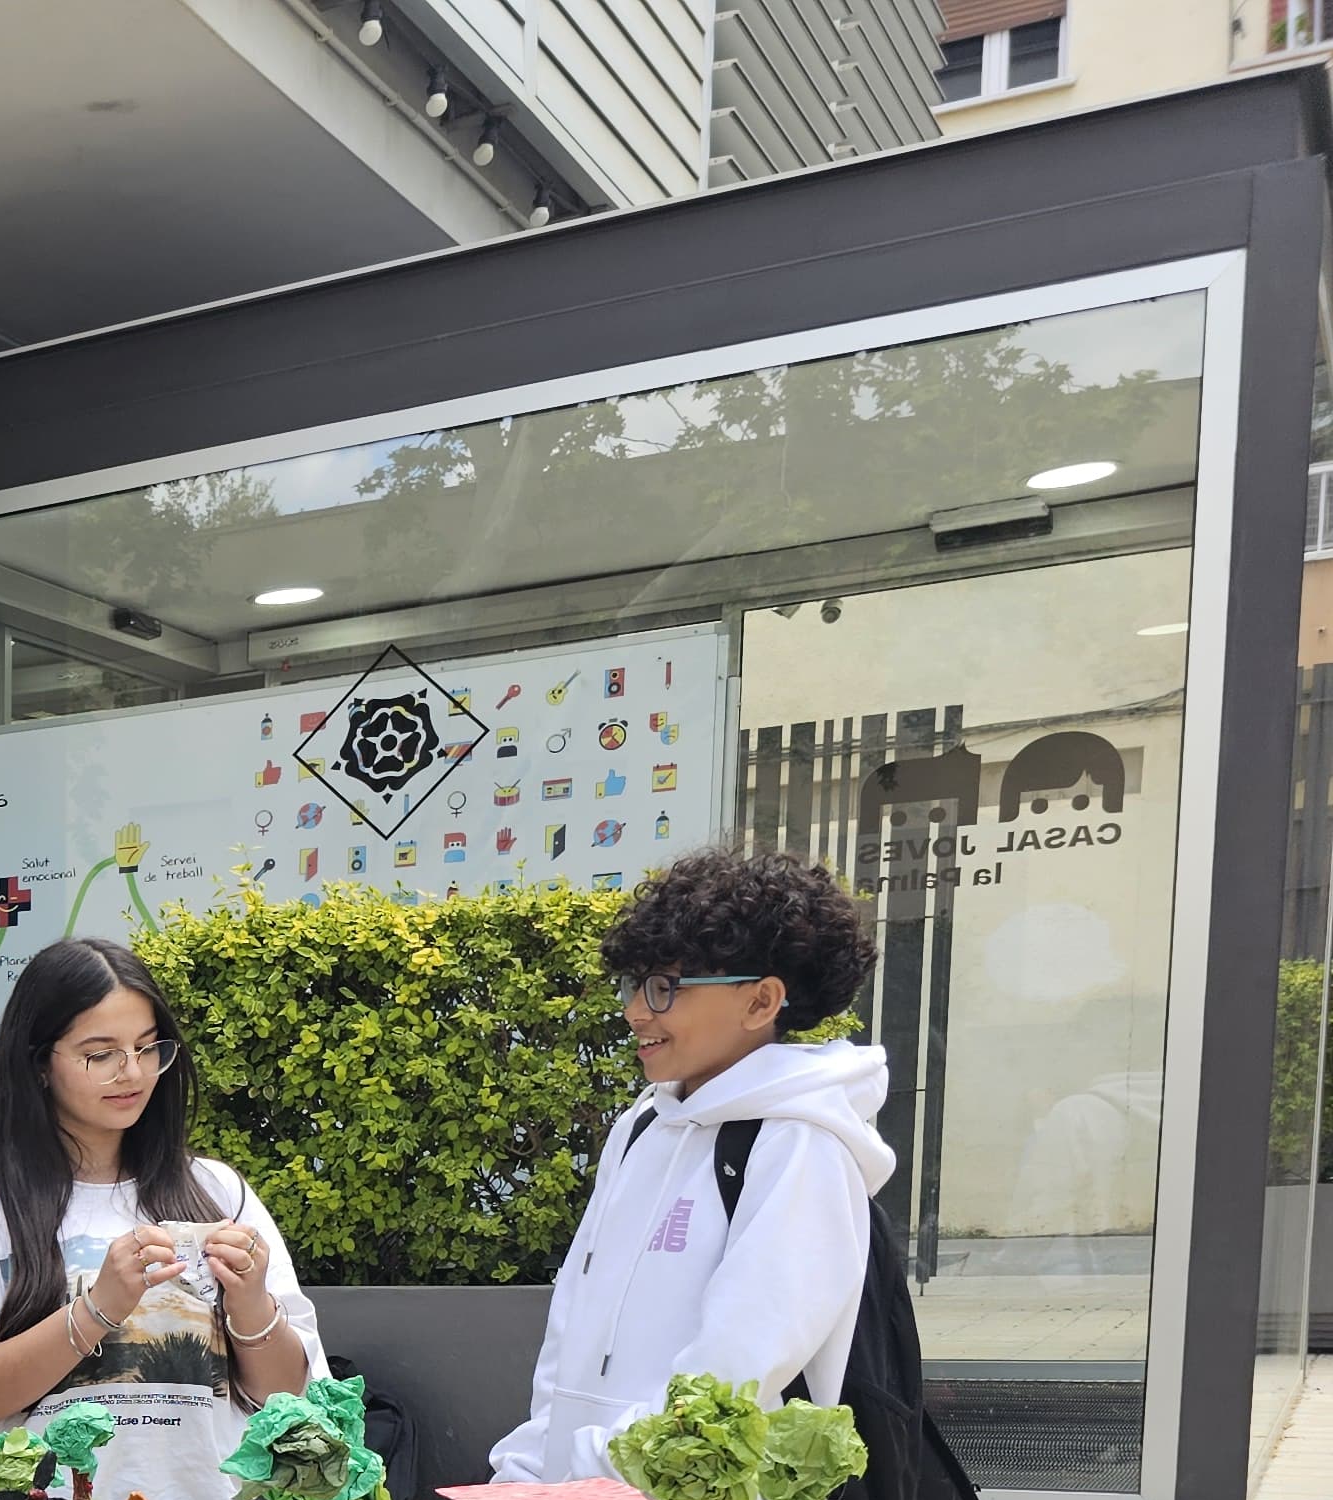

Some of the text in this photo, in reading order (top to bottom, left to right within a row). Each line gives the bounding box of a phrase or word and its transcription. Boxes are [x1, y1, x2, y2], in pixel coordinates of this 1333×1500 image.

[21, 857, 50, 870] Salut
[160, 855, 197, 868] Servei
[21, 868, 77, 883] emocional
[143, 867, 204, 884] de treball
[141, 1415, 182, 1427] Desert
